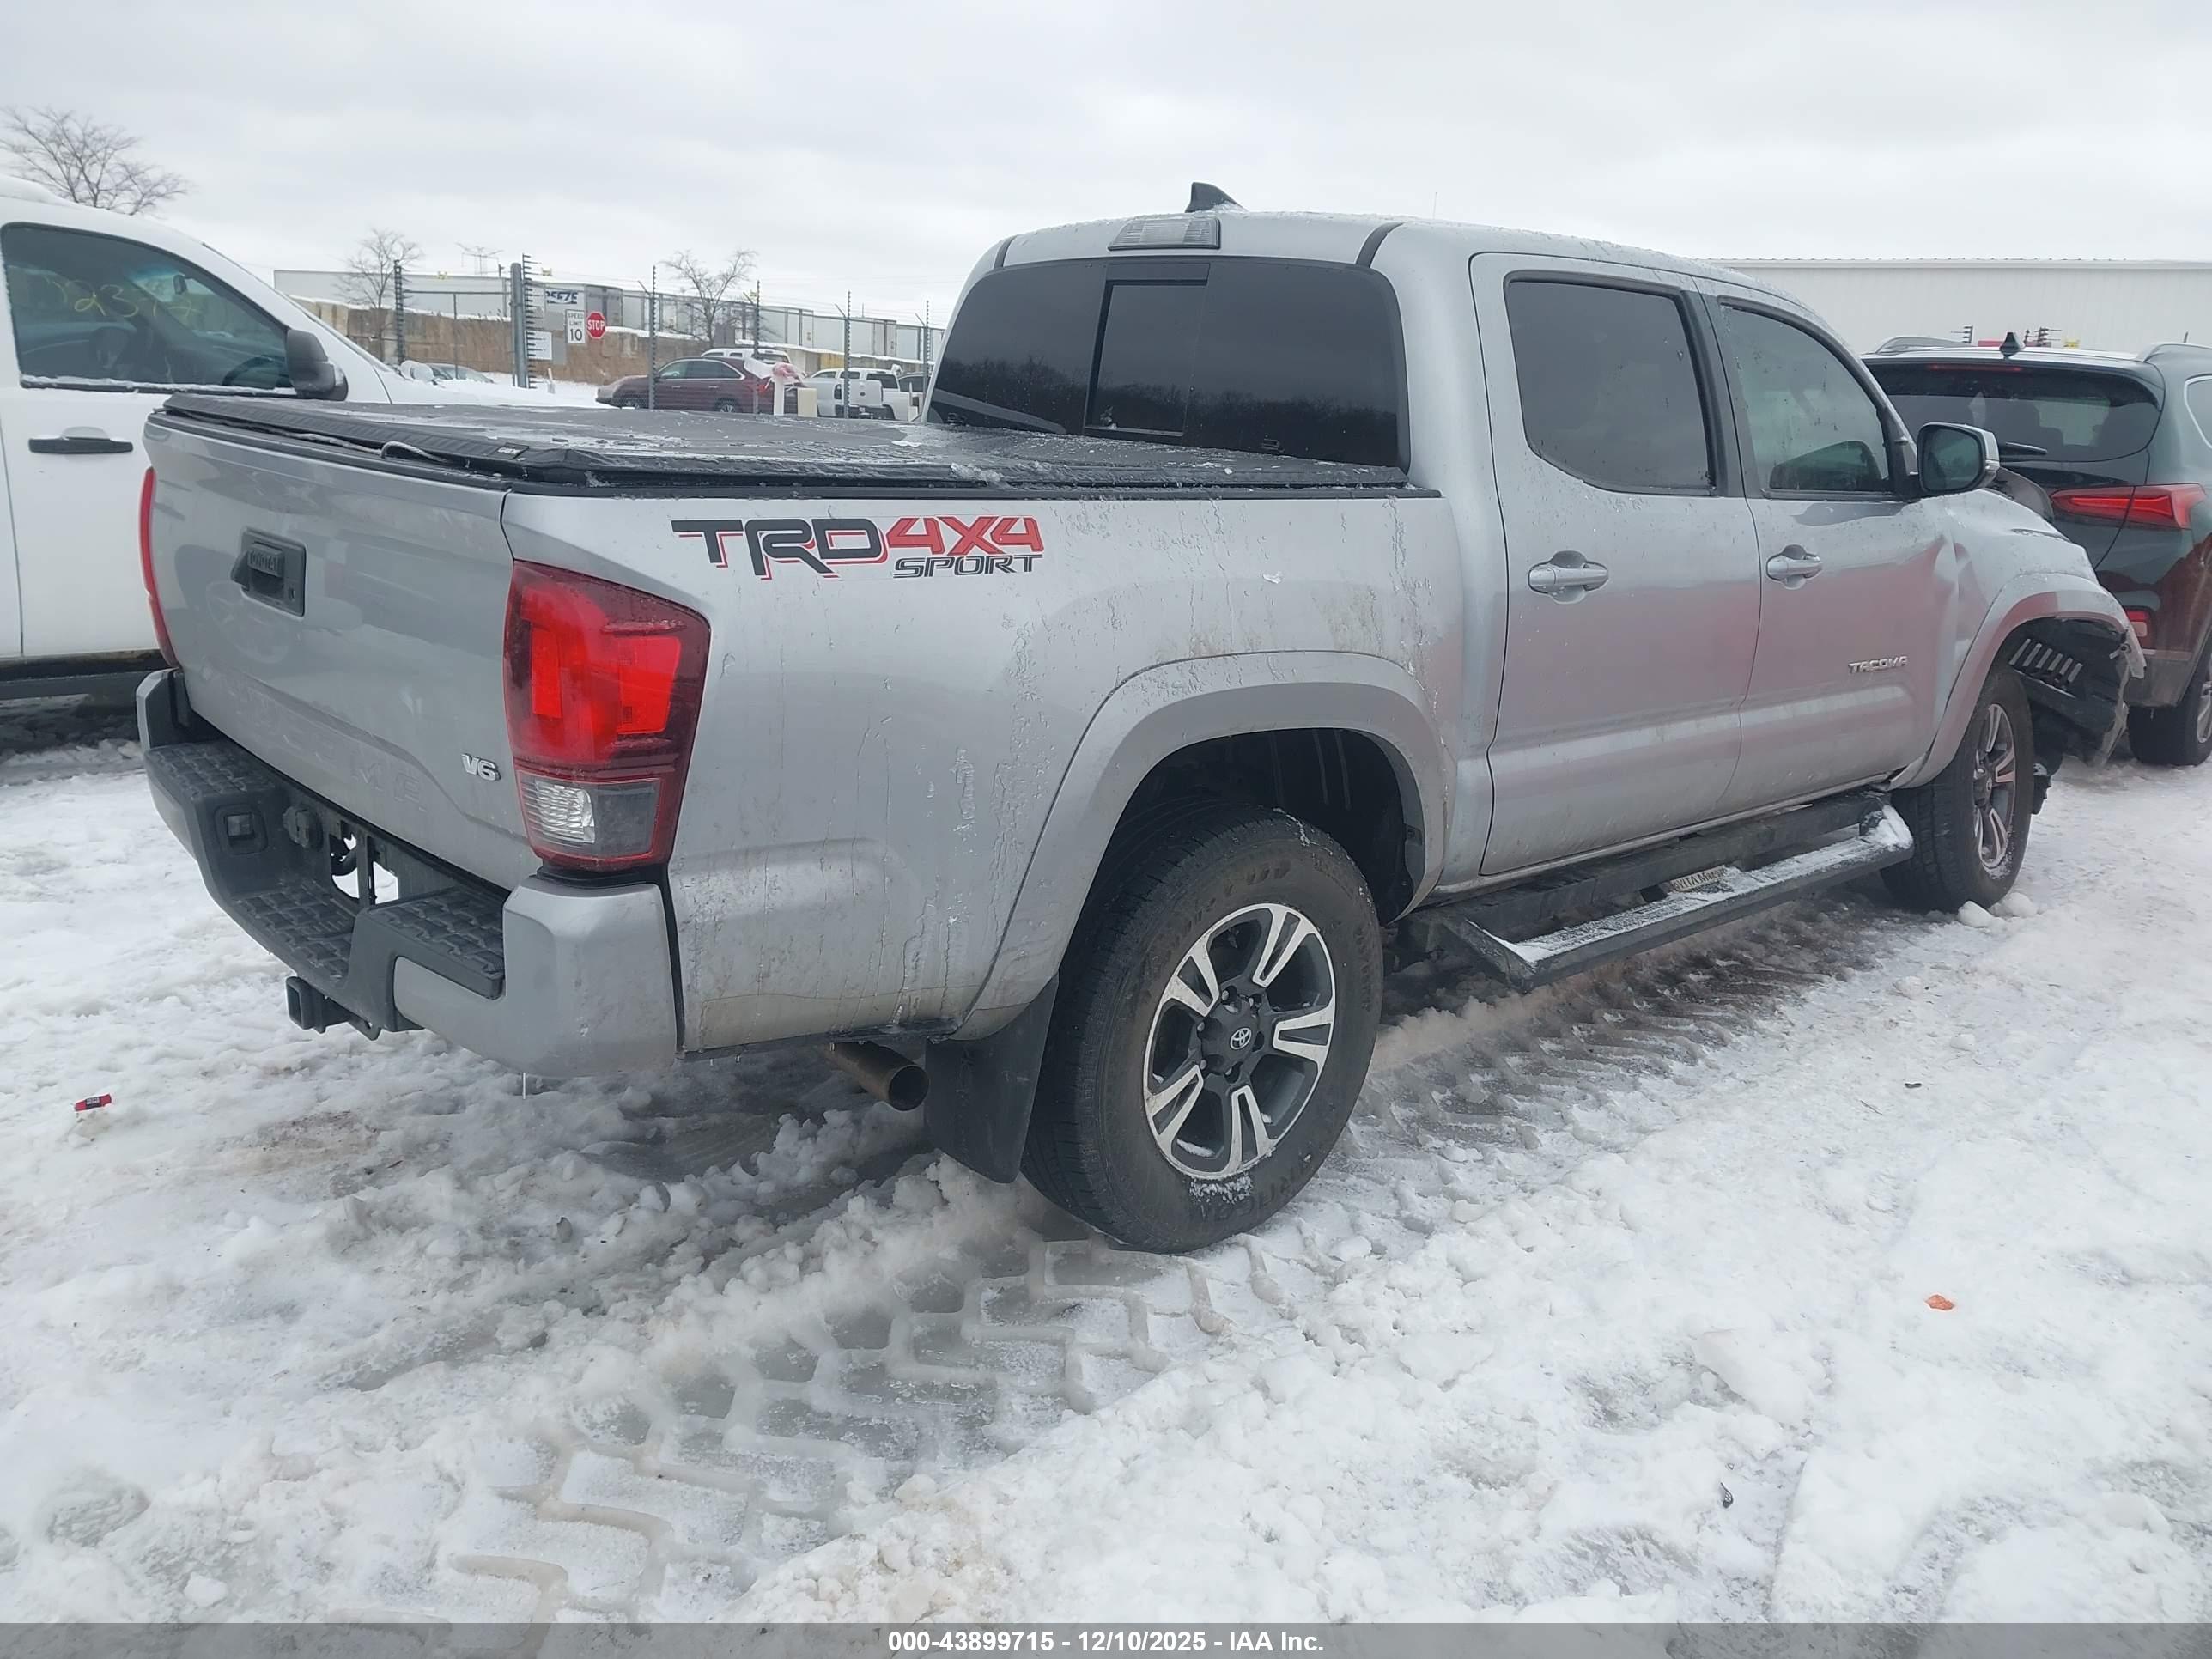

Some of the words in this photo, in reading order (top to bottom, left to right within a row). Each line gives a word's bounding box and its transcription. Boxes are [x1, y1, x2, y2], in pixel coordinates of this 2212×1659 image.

[569, 329, 583, 341] 10
[587, 319, 605, 331] STOP
[672, 518, 889, 580] TRD
[885, 515, 1046, 556] 4X4
[892, 553, 1045, 580] SPORT
[1847, 655, 1908, 674] TACOMA
[461, 752, 501, 782] V6
